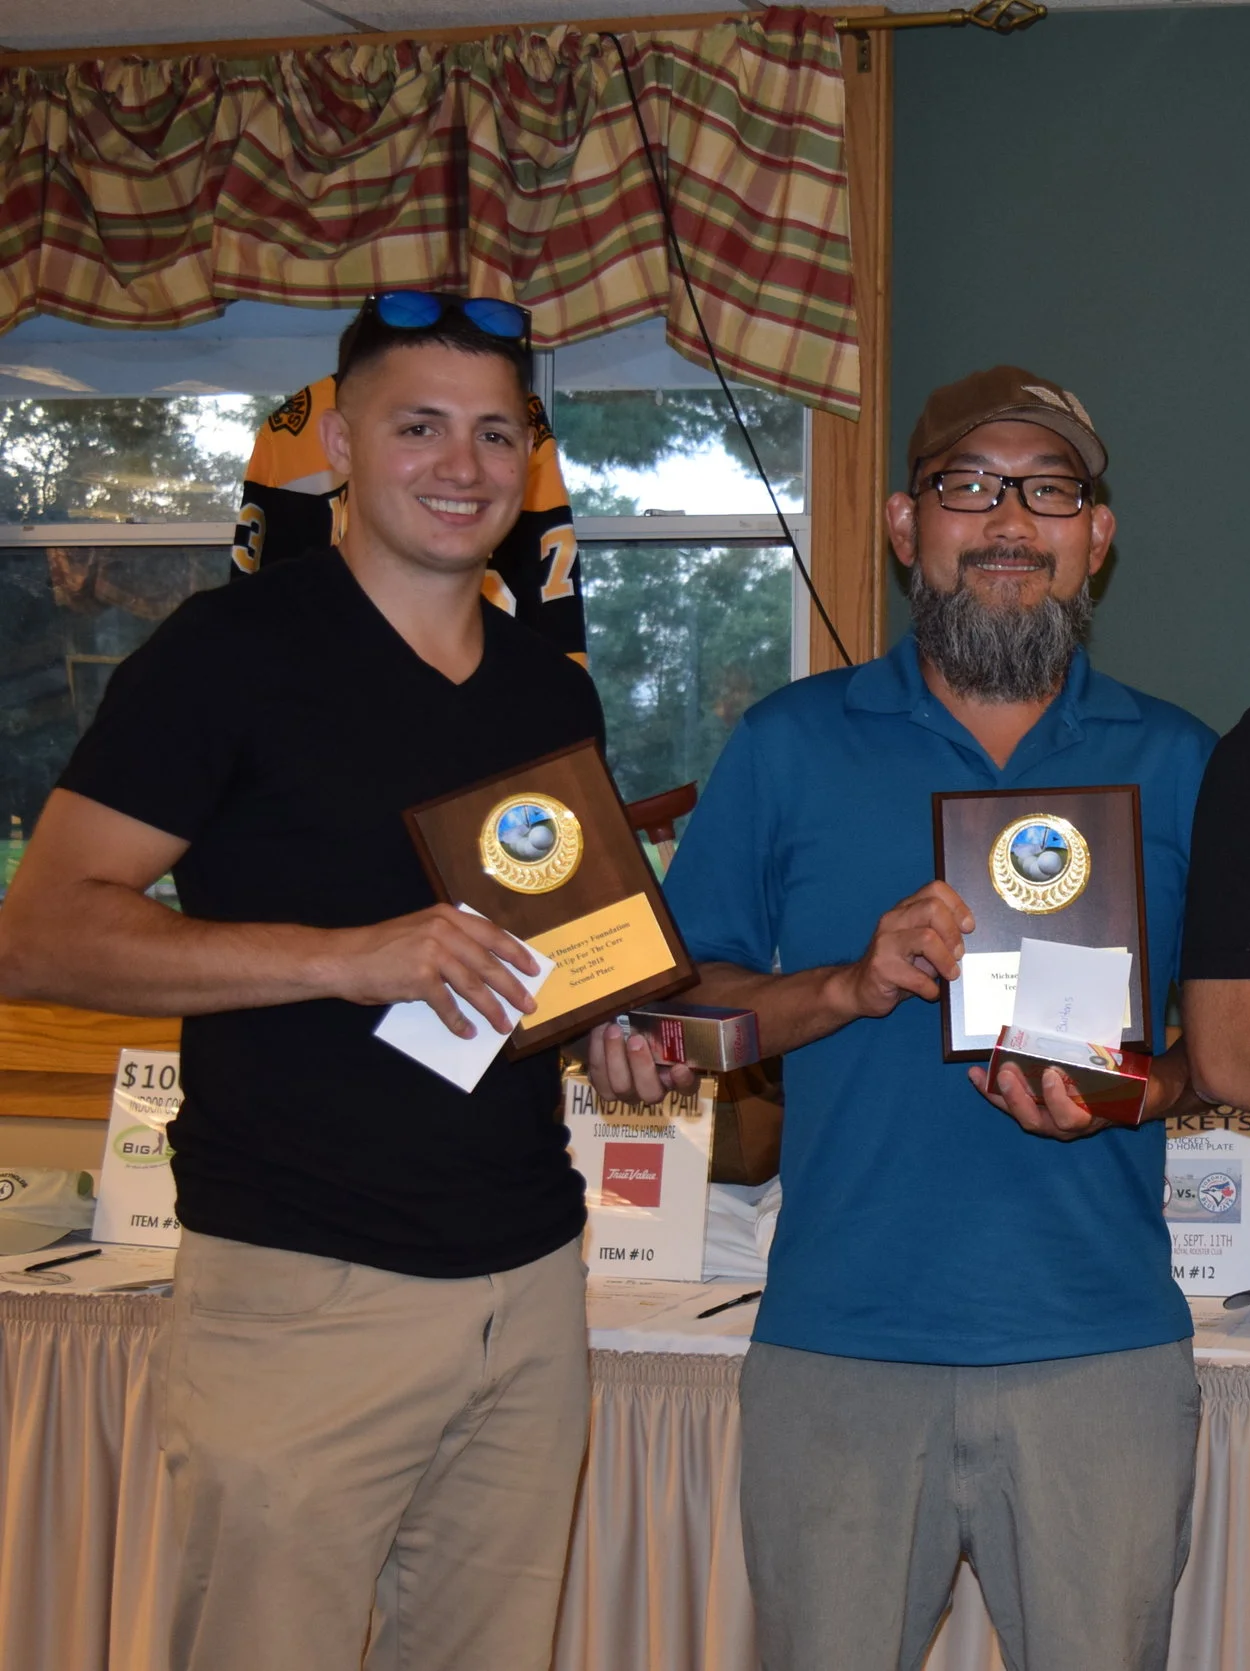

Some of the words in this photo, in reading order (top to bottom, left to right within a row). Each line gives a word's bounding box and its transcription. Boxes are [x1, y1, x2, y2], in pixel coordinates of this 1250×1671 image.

[540, 522, 578, 603] 7
[590, 922, 631, 942] Foundation
[564, 955, 576, 966] Up
[576, 951, 589, 960] For
[591, 945, 604, 954] The
[605, 937, 623, 948] Cure
[569, 964, 587, 976] Sept
[588, 956, 605, 969] 2018
[568, 973, 596, 987] Second
[596, 965, 615, 978] Place
[594, 1123, 620, 1138] $100.00
[621, 1124, 639, 1139] FELLS
[640, 1124, 676, 1139] HARDWARE
[122, 1142, 151, 1155] BIG
[1201, 1175, 1228, 1188] TORONTO
[131, 1214, 159, 1228] ITEM
[162, 1216, 180, 1230] #8
[1183, 1234, 1207, 1248] SEPT.
[1210, 1234, 1233, 1247] 11TH
[600, 1247, 626, 1261] ITEM
[630, 1248, 654, 1261] #10
[1189, 1265, 1215, 1280] #12
